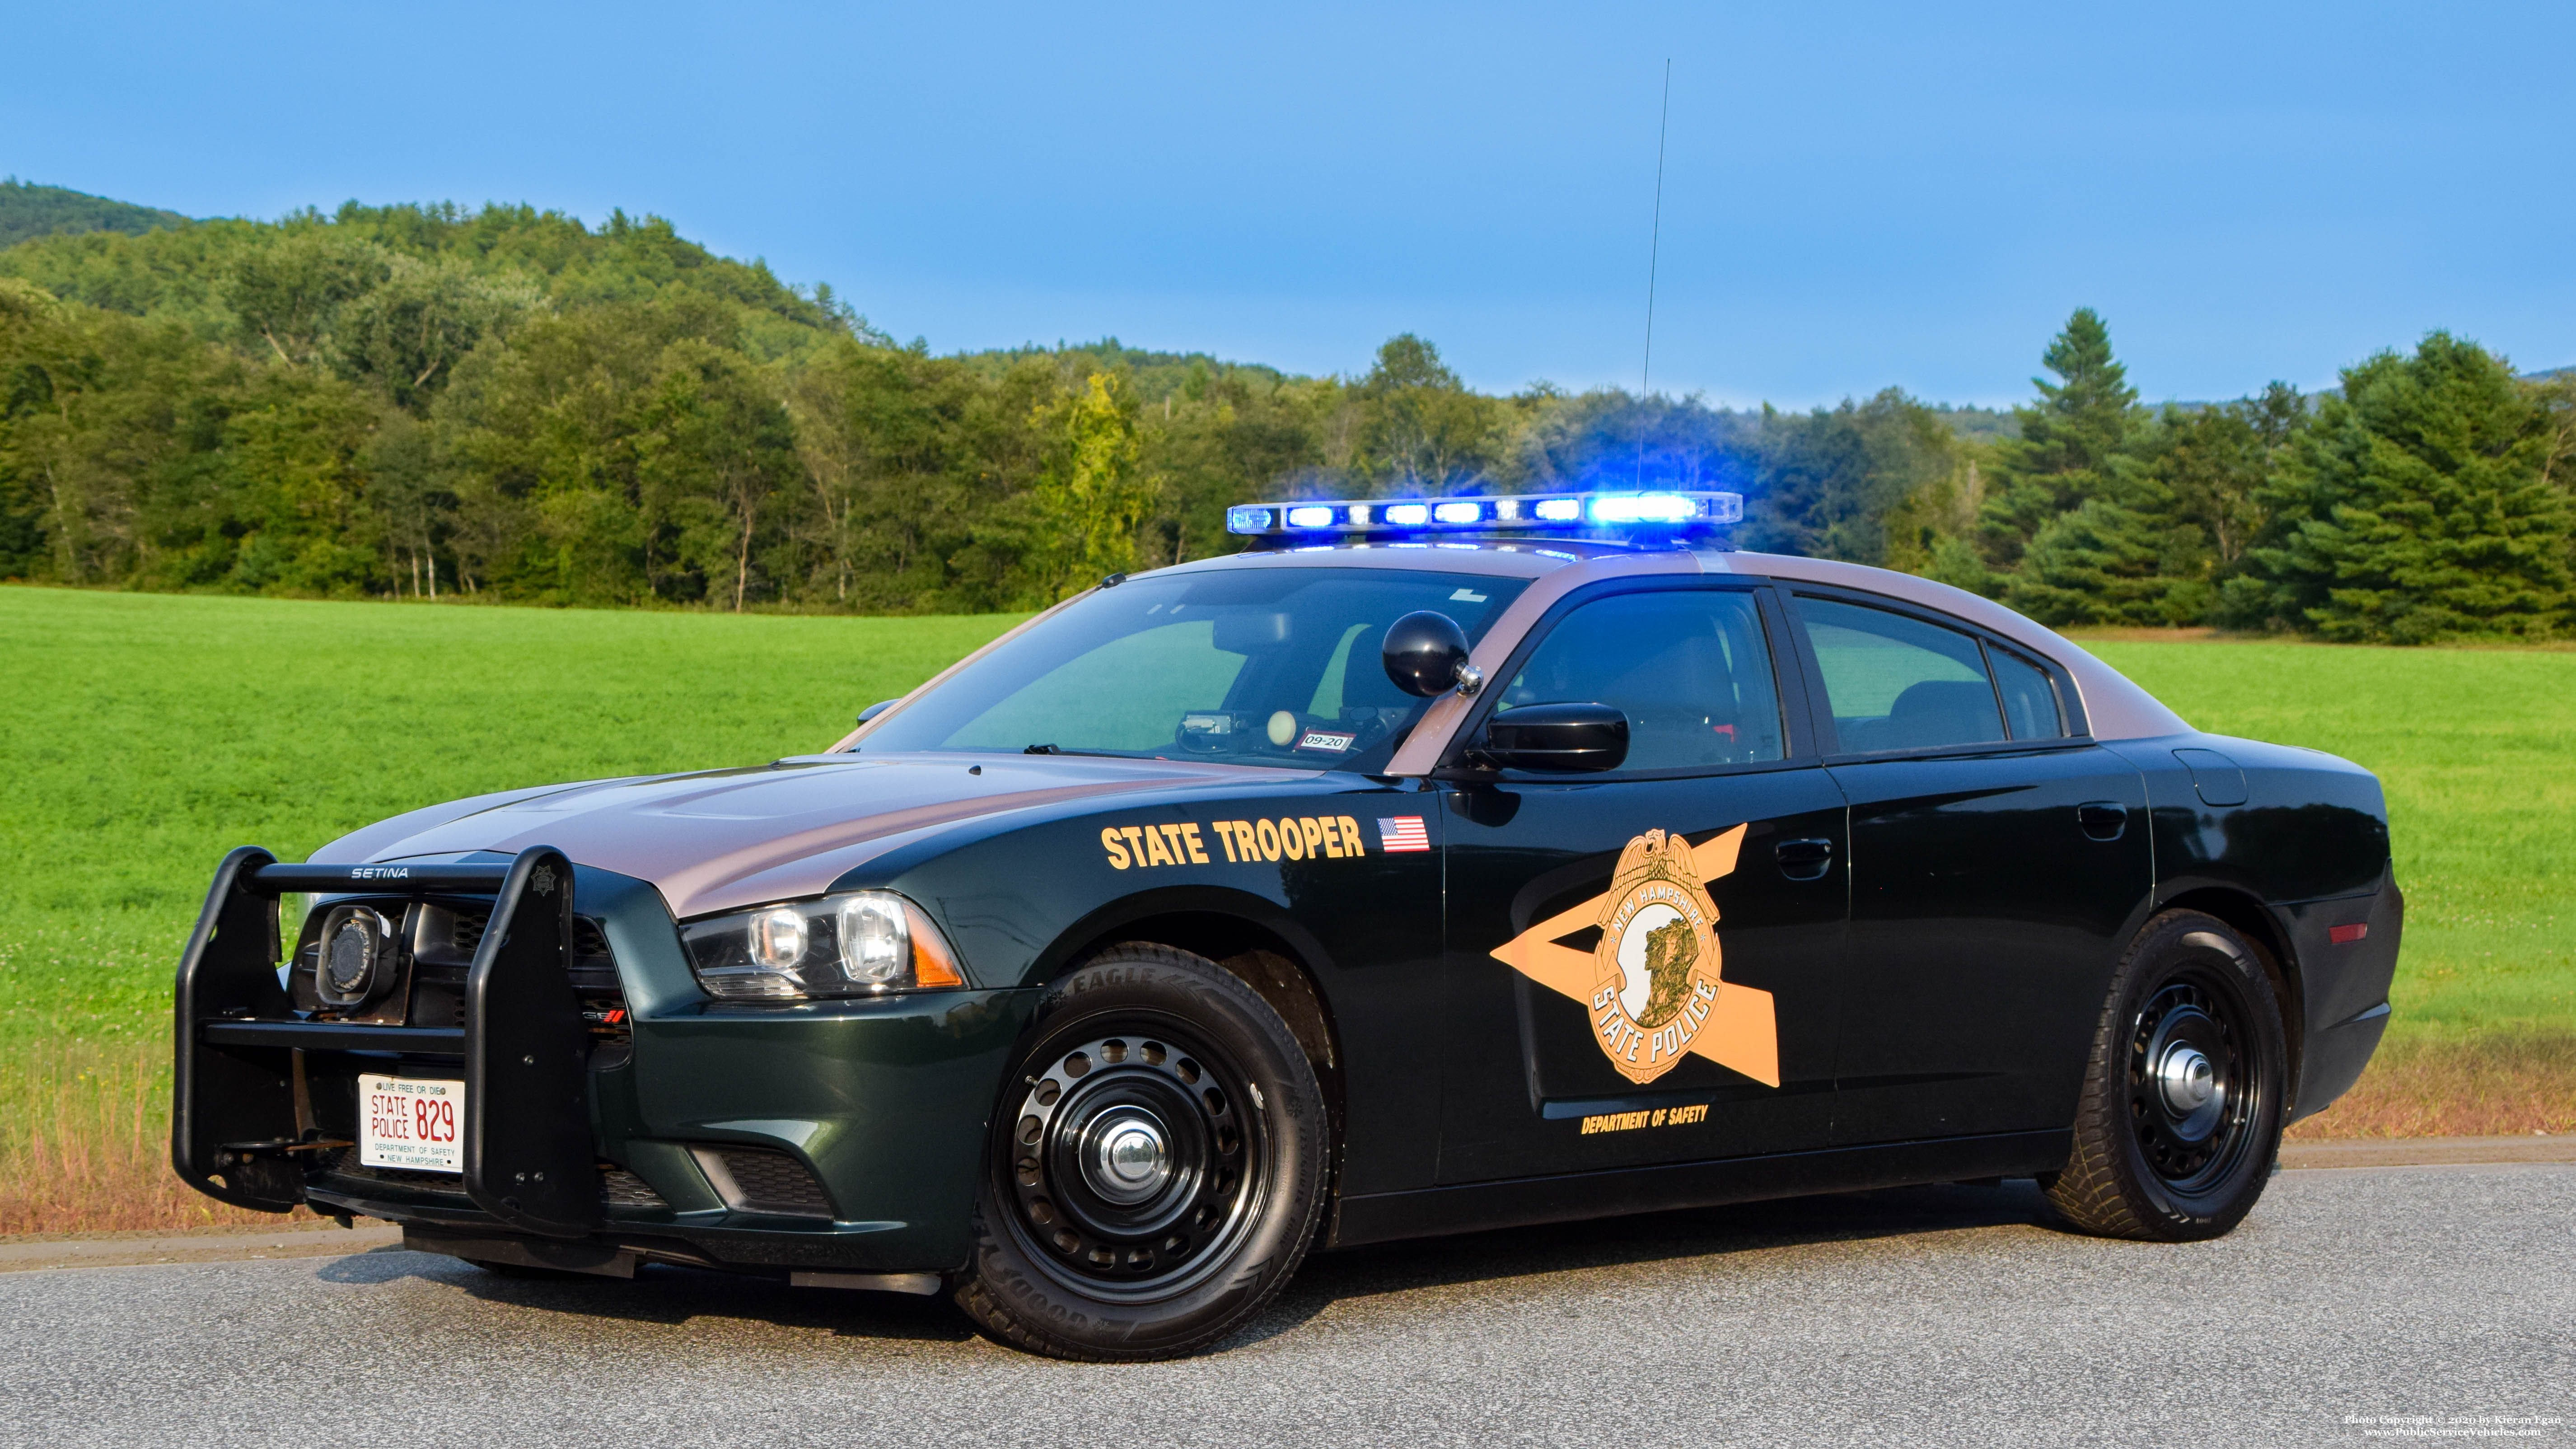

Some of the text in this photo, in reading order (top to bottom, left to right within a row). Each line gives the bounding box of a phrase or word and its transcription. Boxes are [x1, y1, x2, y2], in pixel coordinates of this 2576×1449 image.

[1305, 736, 1343, 746] 09-20
[1101, 816, 1365, 870] STATE TROOPER
[351, 868, 408, 879] SETINA
[1613, 886, 1703, 932] NEW HAMPSHIRE
[1073, 968, 1156, 994] EAGLE
[1593, 979, 1718, 1063] STATE POLICE
[383, 1083, 441, 1095] LIVE FREE OR DIE
[372, 1095, 454, 1142] STATE 829
[372, 1117, 409, 1139] POLICE
[1581, 1105, 1709, 1135] DEPARTMENT OF SAFETY
[375, 1143, 415, 1153] DEPARTMENT
[431, 1148, 454, 1156] SAFETY
[406, 1157, 444, 1166] HAMPSHIRE
